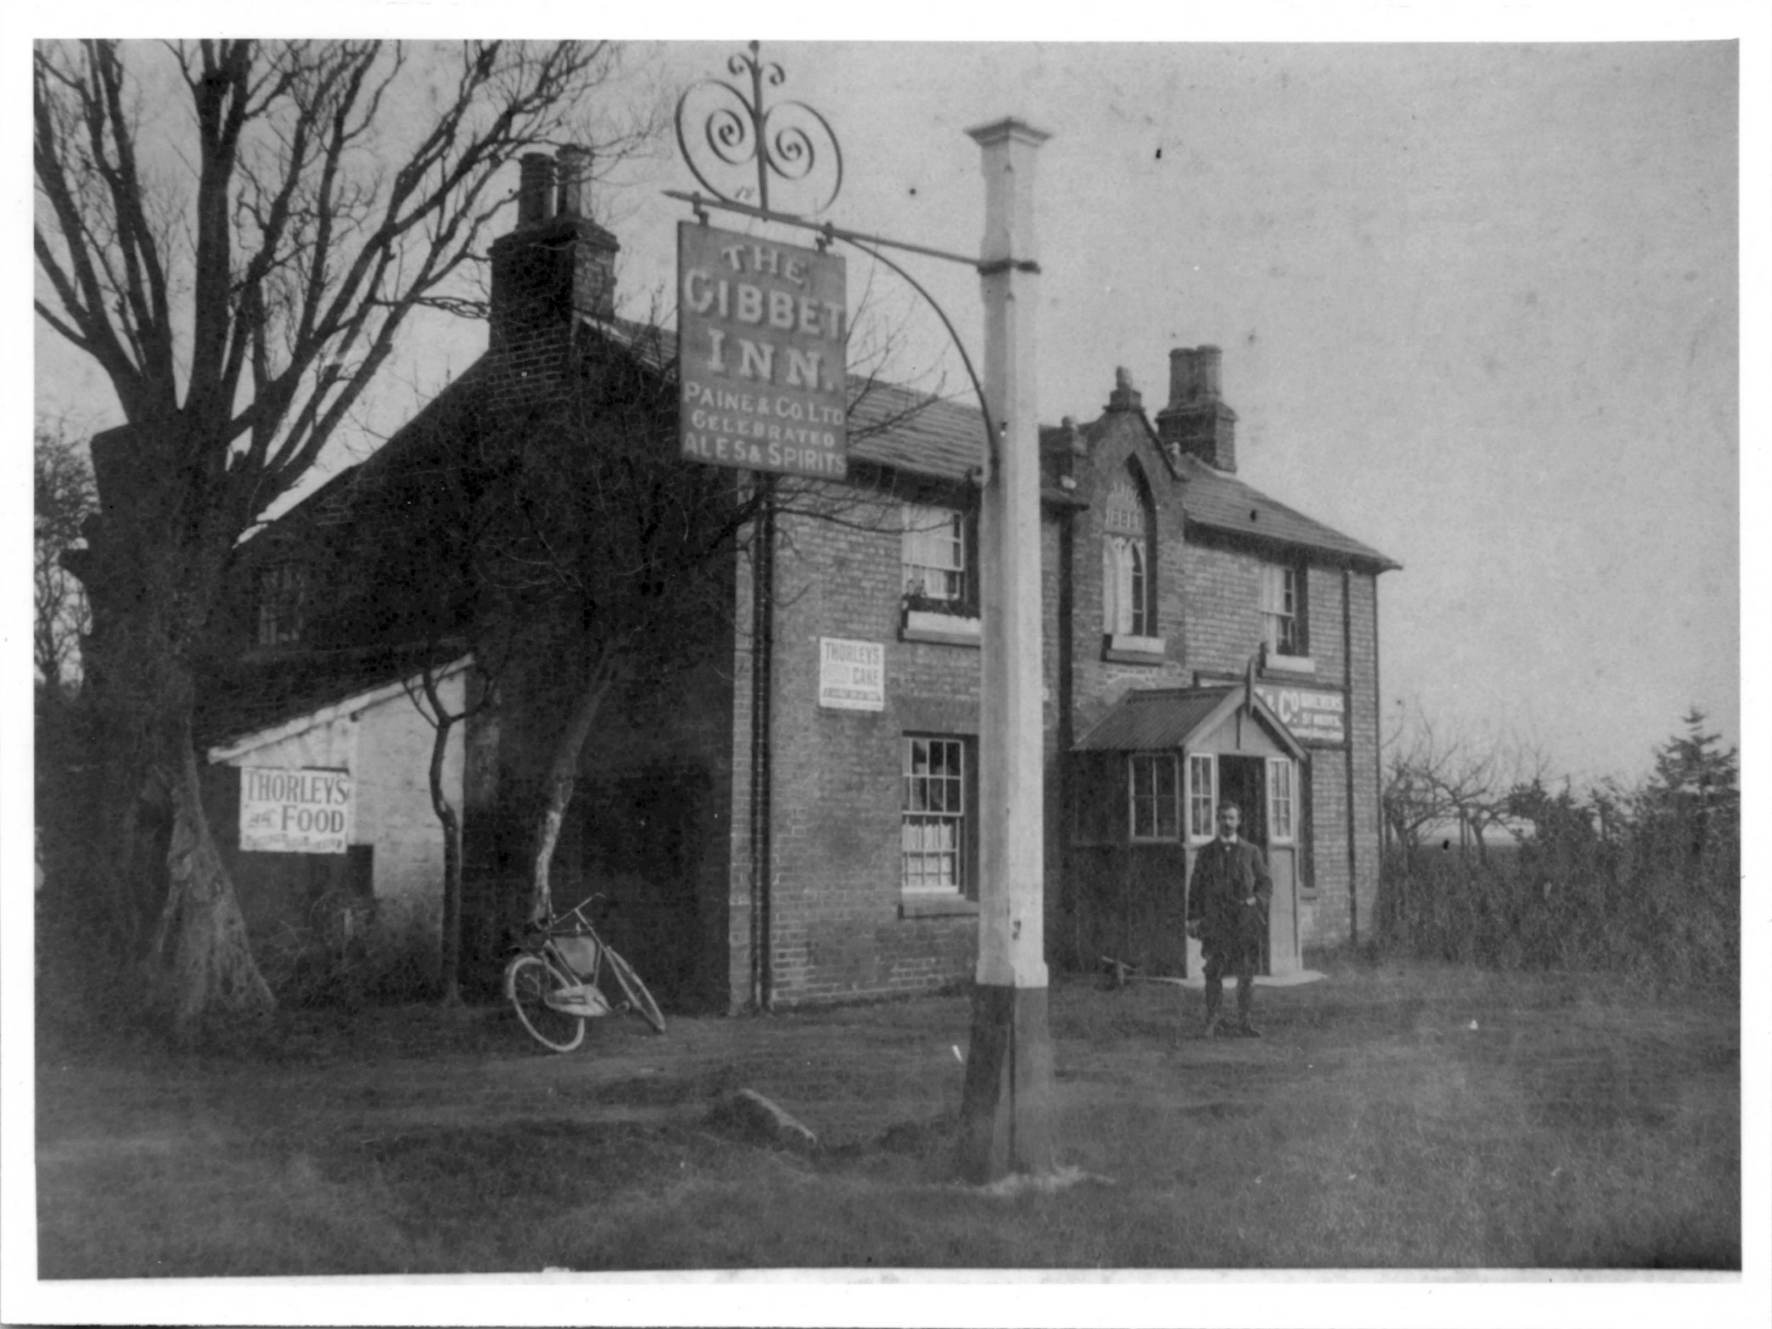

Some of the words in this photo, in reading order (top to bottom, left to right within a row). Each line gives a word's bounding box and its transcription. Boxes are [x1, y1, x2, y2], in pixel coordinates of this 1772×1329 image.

[721, 244, 808, 285] THE
[684, 267, 844, 340] GIBBET
[691, 409, 836, 448] CELEBRATED
[684, 431, 747, 461] ALES
[768, 442, 847, 475] SPIRITS
[281, 804, 344, 834] FOOD
